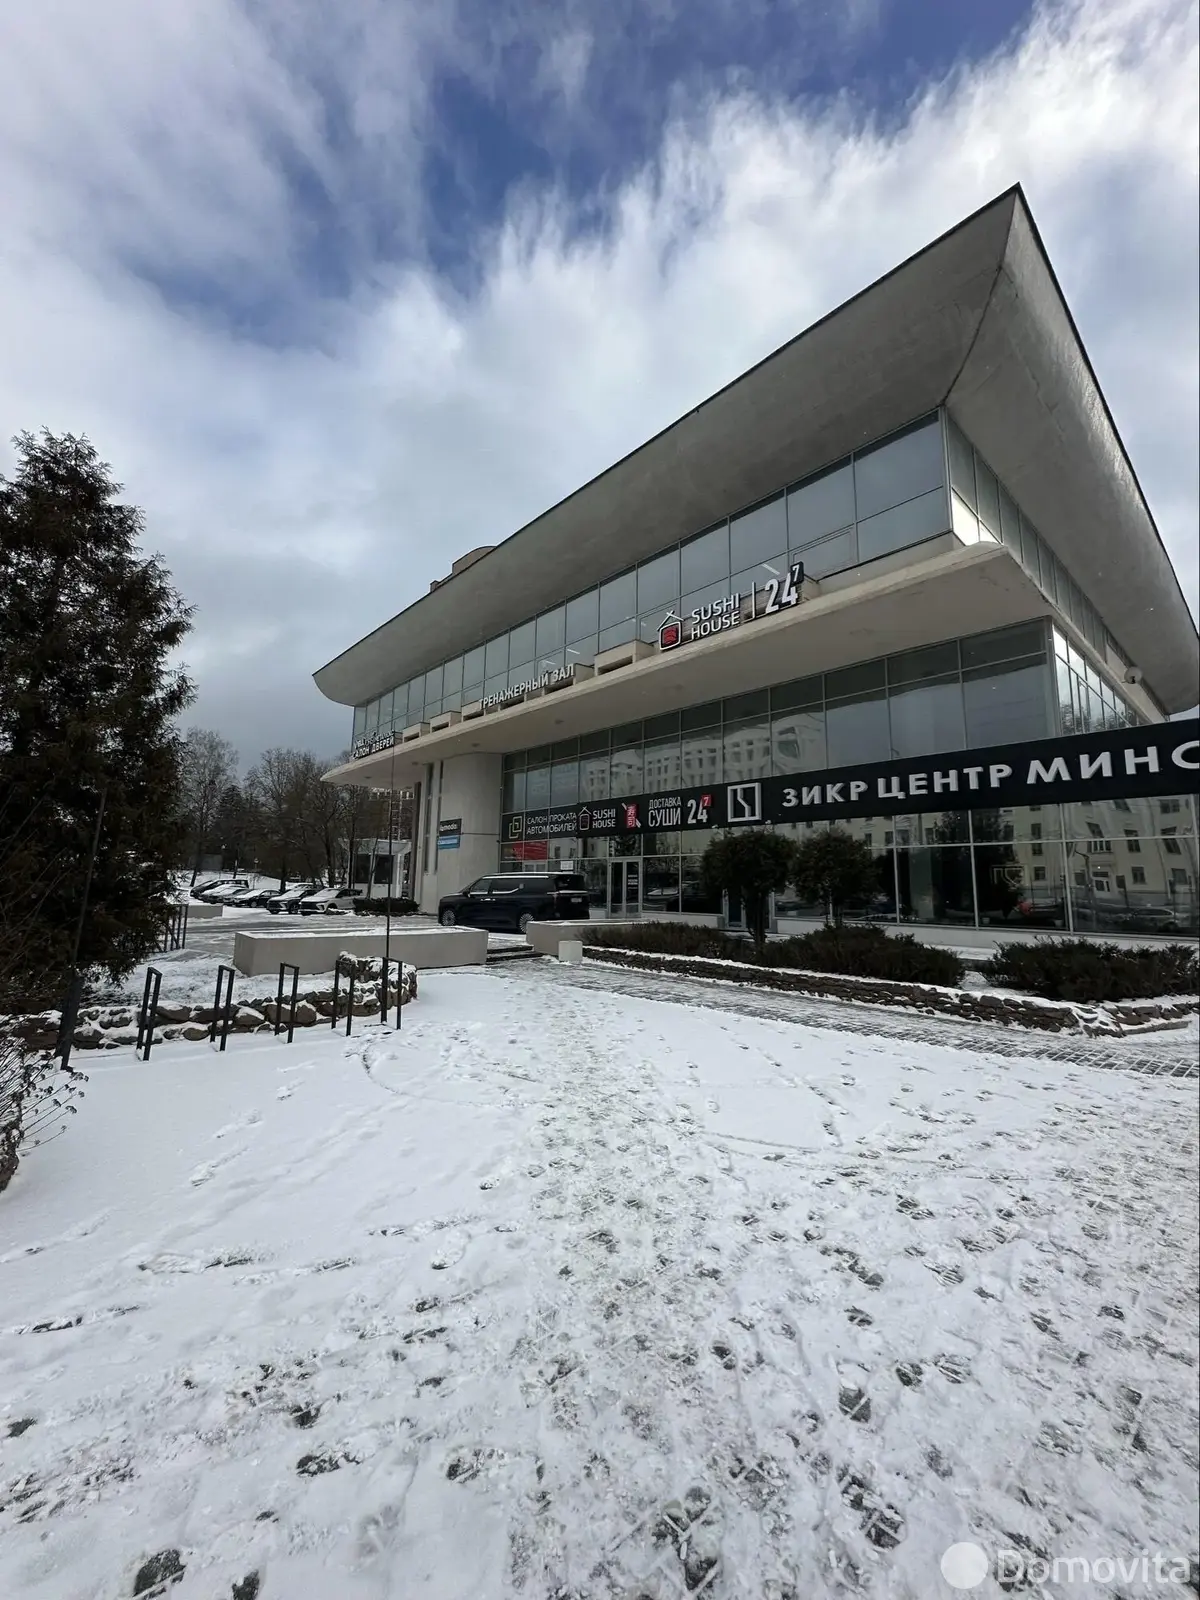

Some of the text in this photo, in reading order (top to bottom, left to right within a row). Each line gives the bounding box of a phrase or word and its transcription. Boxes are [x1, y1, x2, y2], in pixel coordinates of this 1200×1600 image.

[691, 592, 740, 624] SUSHI
[691, 610, 740, 640] HOUSE
[479, 663, 575, 710] ТРЕНАЖЕРНЫЙ ЗАЛ
[782, 780, 869, 807] ЗИКР
[877, 764, 1013, 799] ЦЕНТР
[648, 796, 682, 810] ДОСТАВКА
[527, 812, 577, 825] САЛОН ПРОКАТА
[592, 808, 616, 820] SUSHI
[648, 807, 681, 827] СУШИ
[526, 819, 577, 835] АВТОМОБИЛЕЙ
[592, 818, 616, 829] HOUSE
